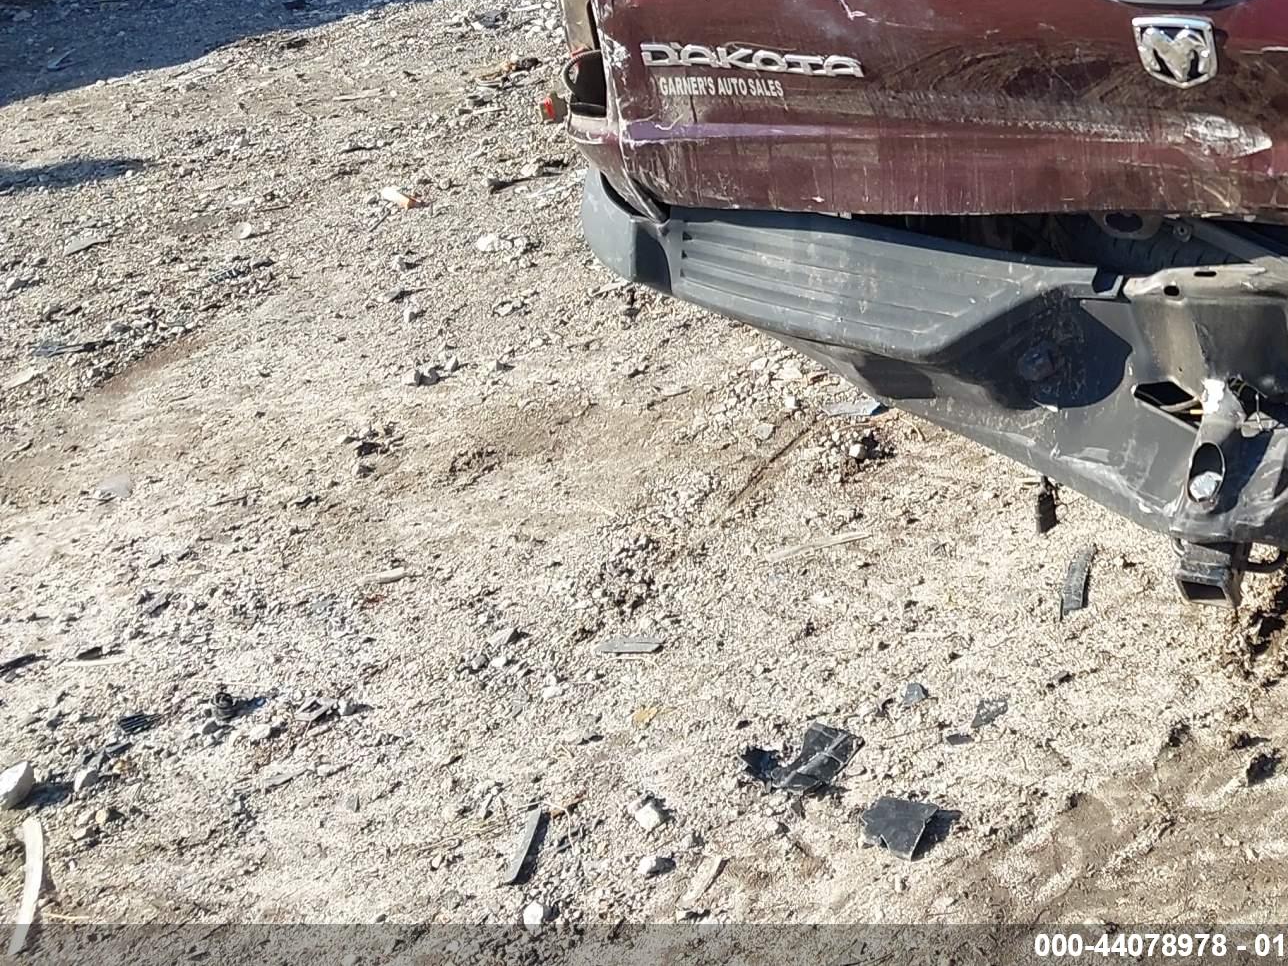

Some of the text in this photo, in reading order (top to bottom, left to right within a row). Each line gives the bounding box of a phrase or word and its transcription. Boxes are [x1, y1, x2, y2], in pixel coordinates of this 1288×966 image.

[640, 42, 865, 78] DAKOTA
[659, 76, 784, 97] GARNER'S AUTO SALES
